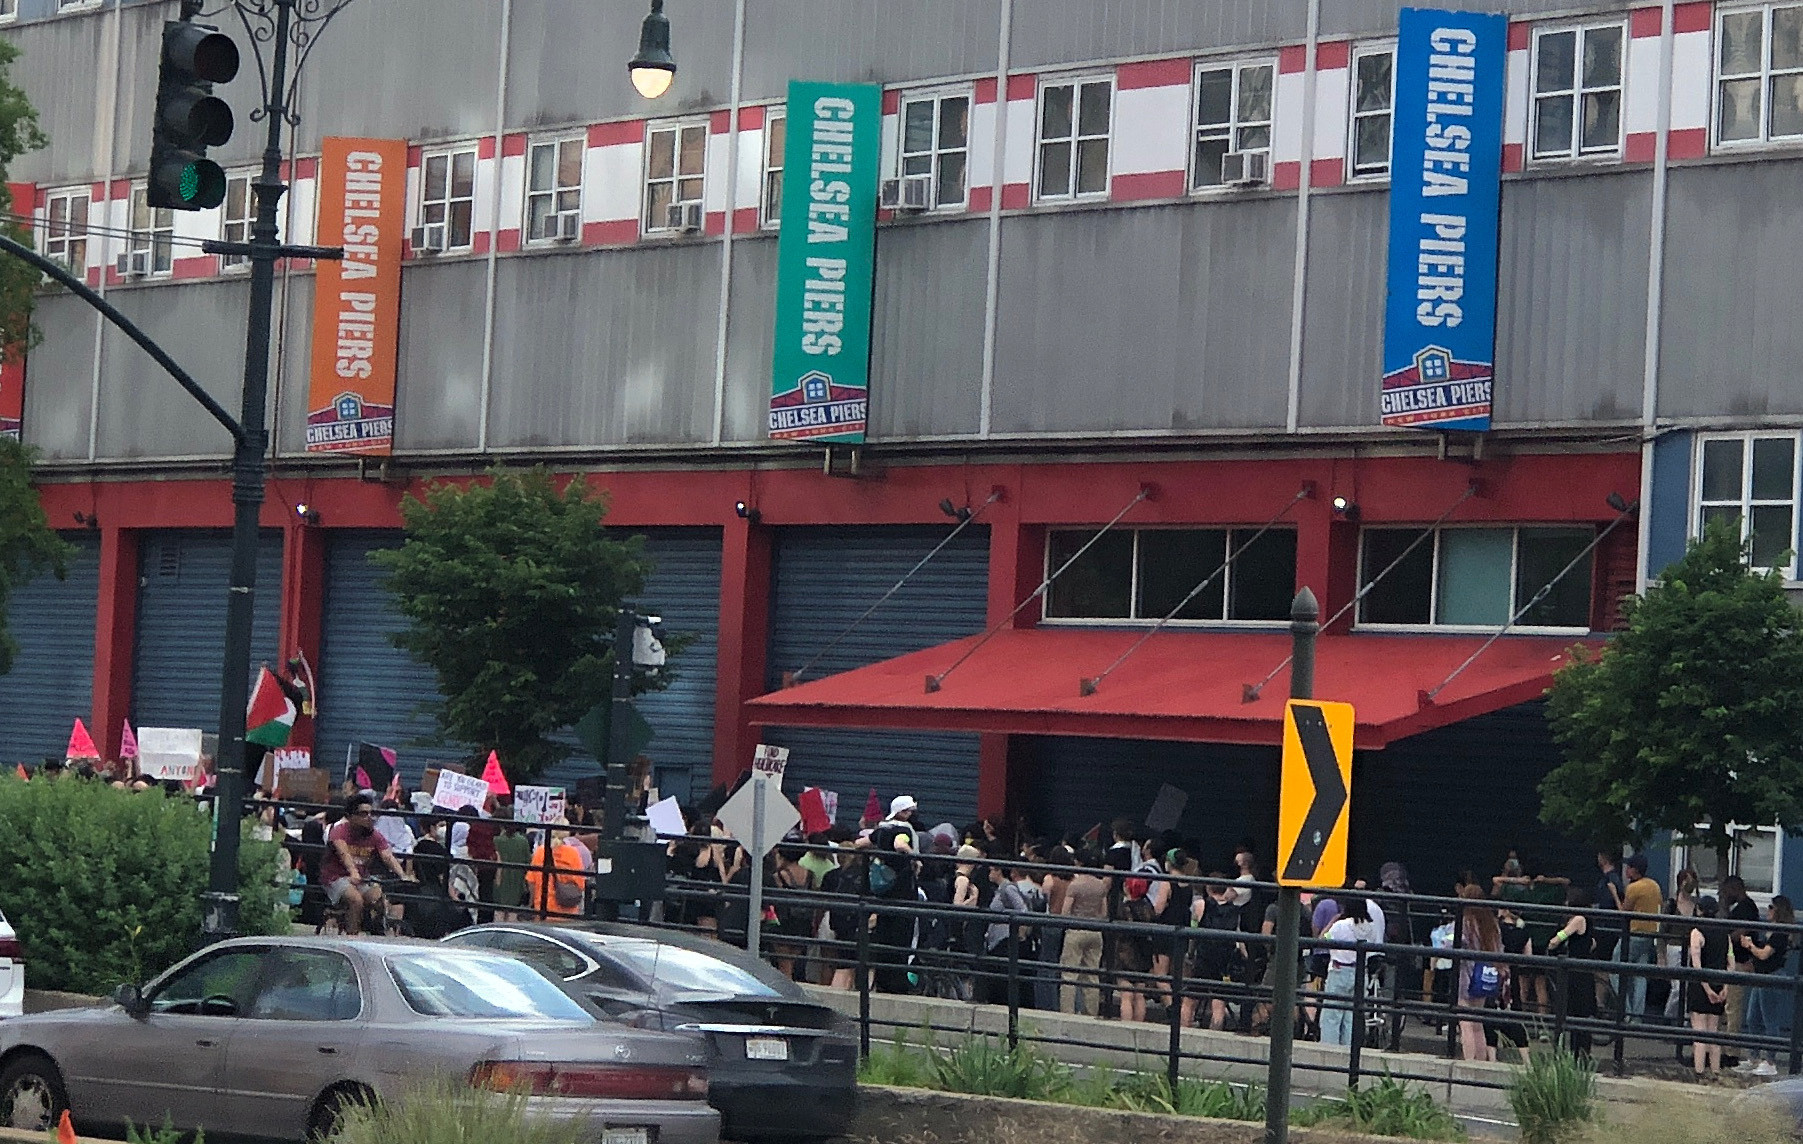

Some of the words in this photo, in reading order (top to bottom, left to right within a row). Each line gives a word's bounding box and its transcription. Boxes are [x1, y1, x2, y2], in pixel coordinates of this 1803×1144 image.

[1423, 28, 1477, 198] CHELSEA
[340, 151, 383, 280] CHELSEA
[807, 96, 855, 243] CHELSEA
[802, 257, 847, 356] PIERS
[1416, 213, 1467, 327] PIERS
[335, 292, 376, 379] PIERS
[306, 423, 357, 443] CHELSEA
[769, 406, 827, 429] CHELSEA
[1381, 387, 1447, 413] CHELSEA
[1451, 381, 1491, 405] PIERS
